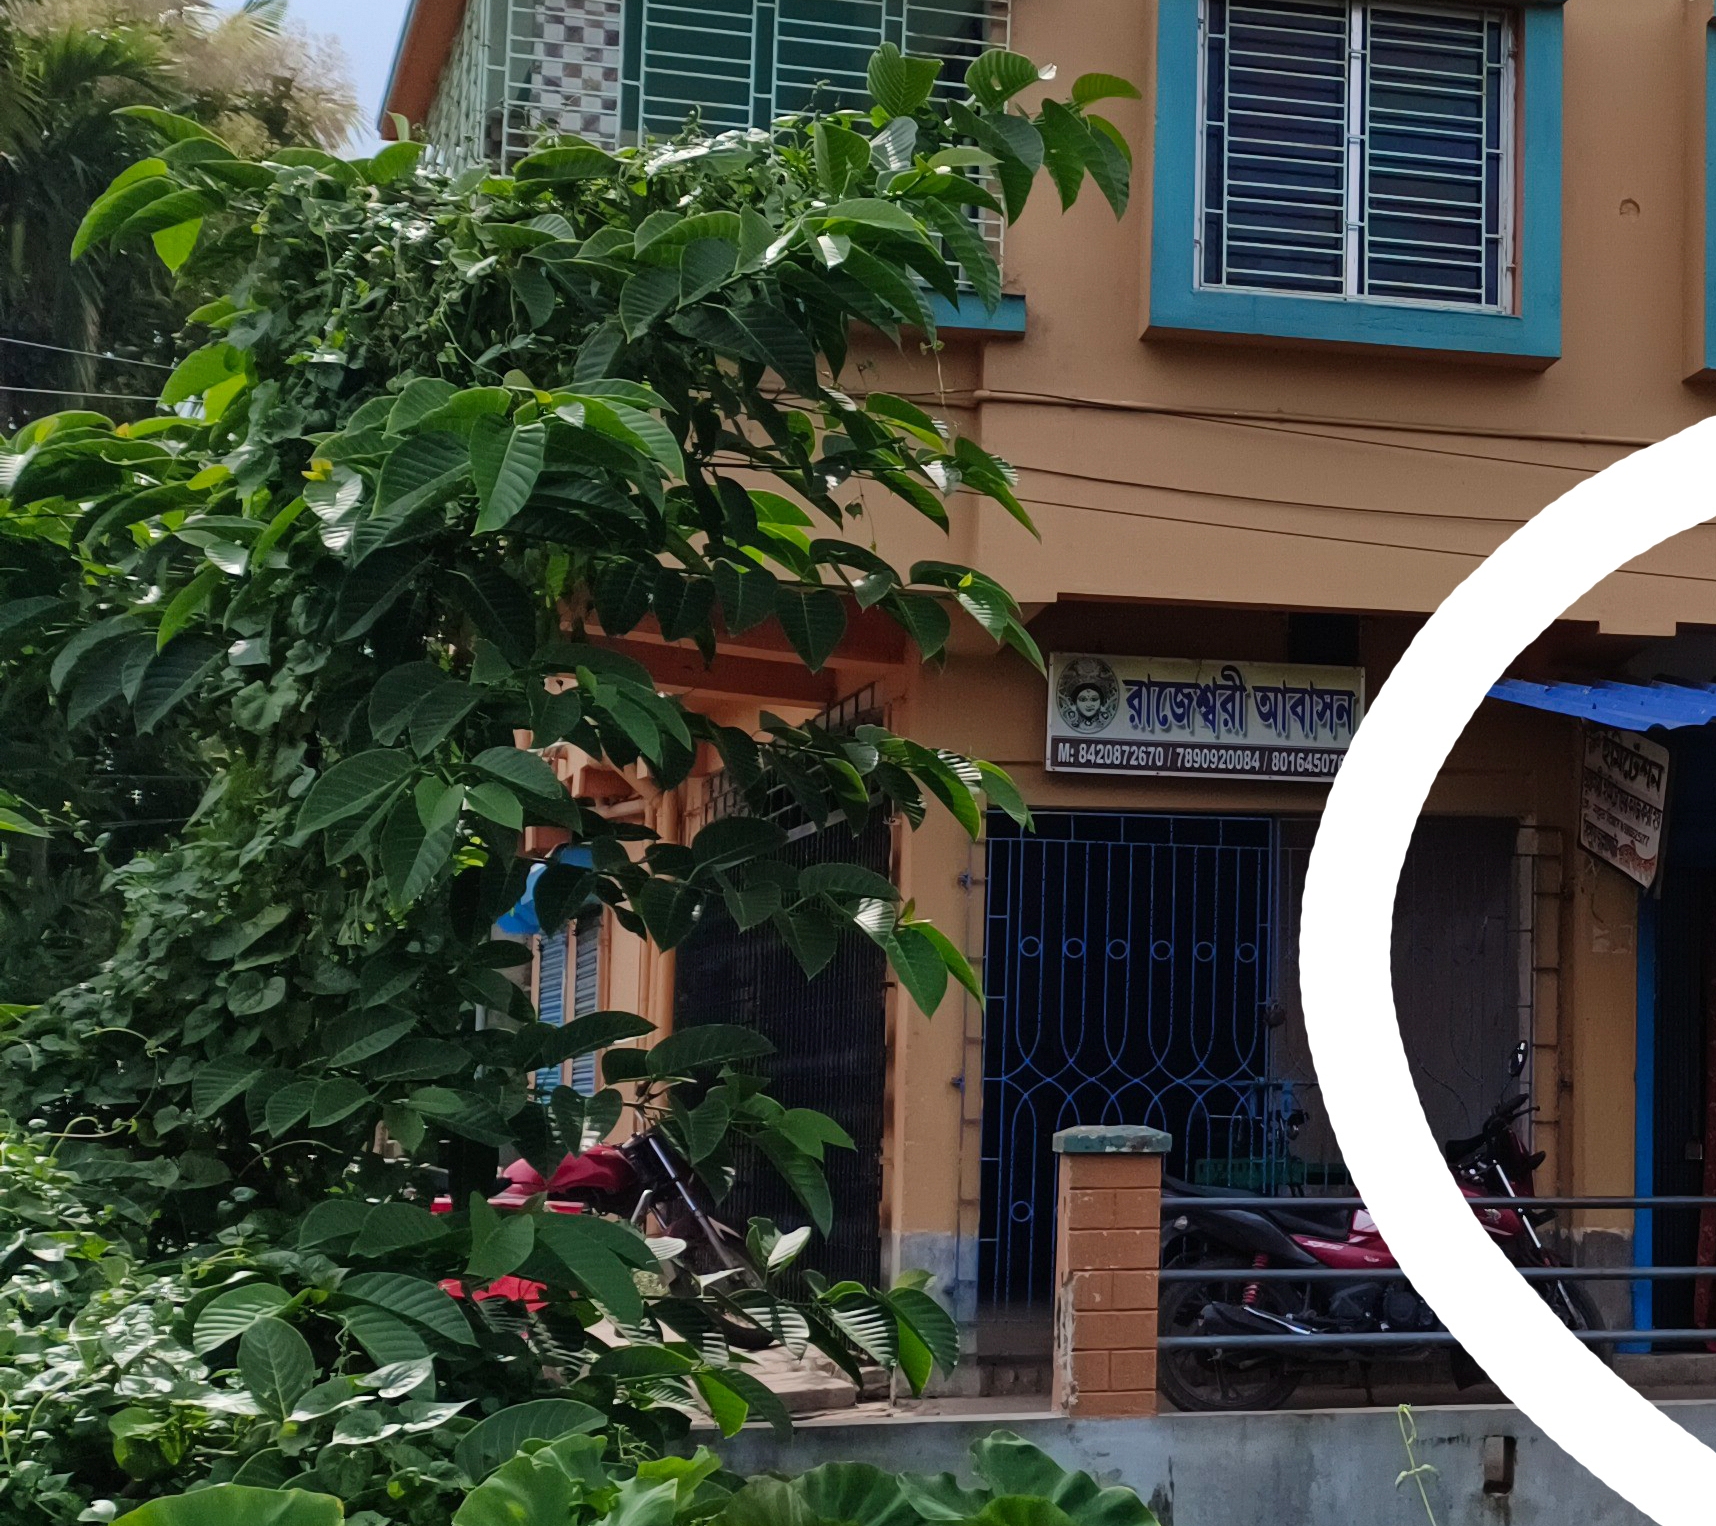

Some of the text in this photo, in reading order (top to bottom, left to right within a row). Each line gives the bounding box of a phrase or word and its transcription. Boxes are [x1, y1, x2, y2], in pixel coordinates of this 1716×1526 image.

[1121, 664, 1356, 737] রাজেশ্বরী আবাসন
[1057, 742, 1075, 764] M:
[1078, 743, 1164, 767] 8420872670
[1175, 747, 1260, 772] 7890920084
[1271, 751, 1346, 774] 801645076
